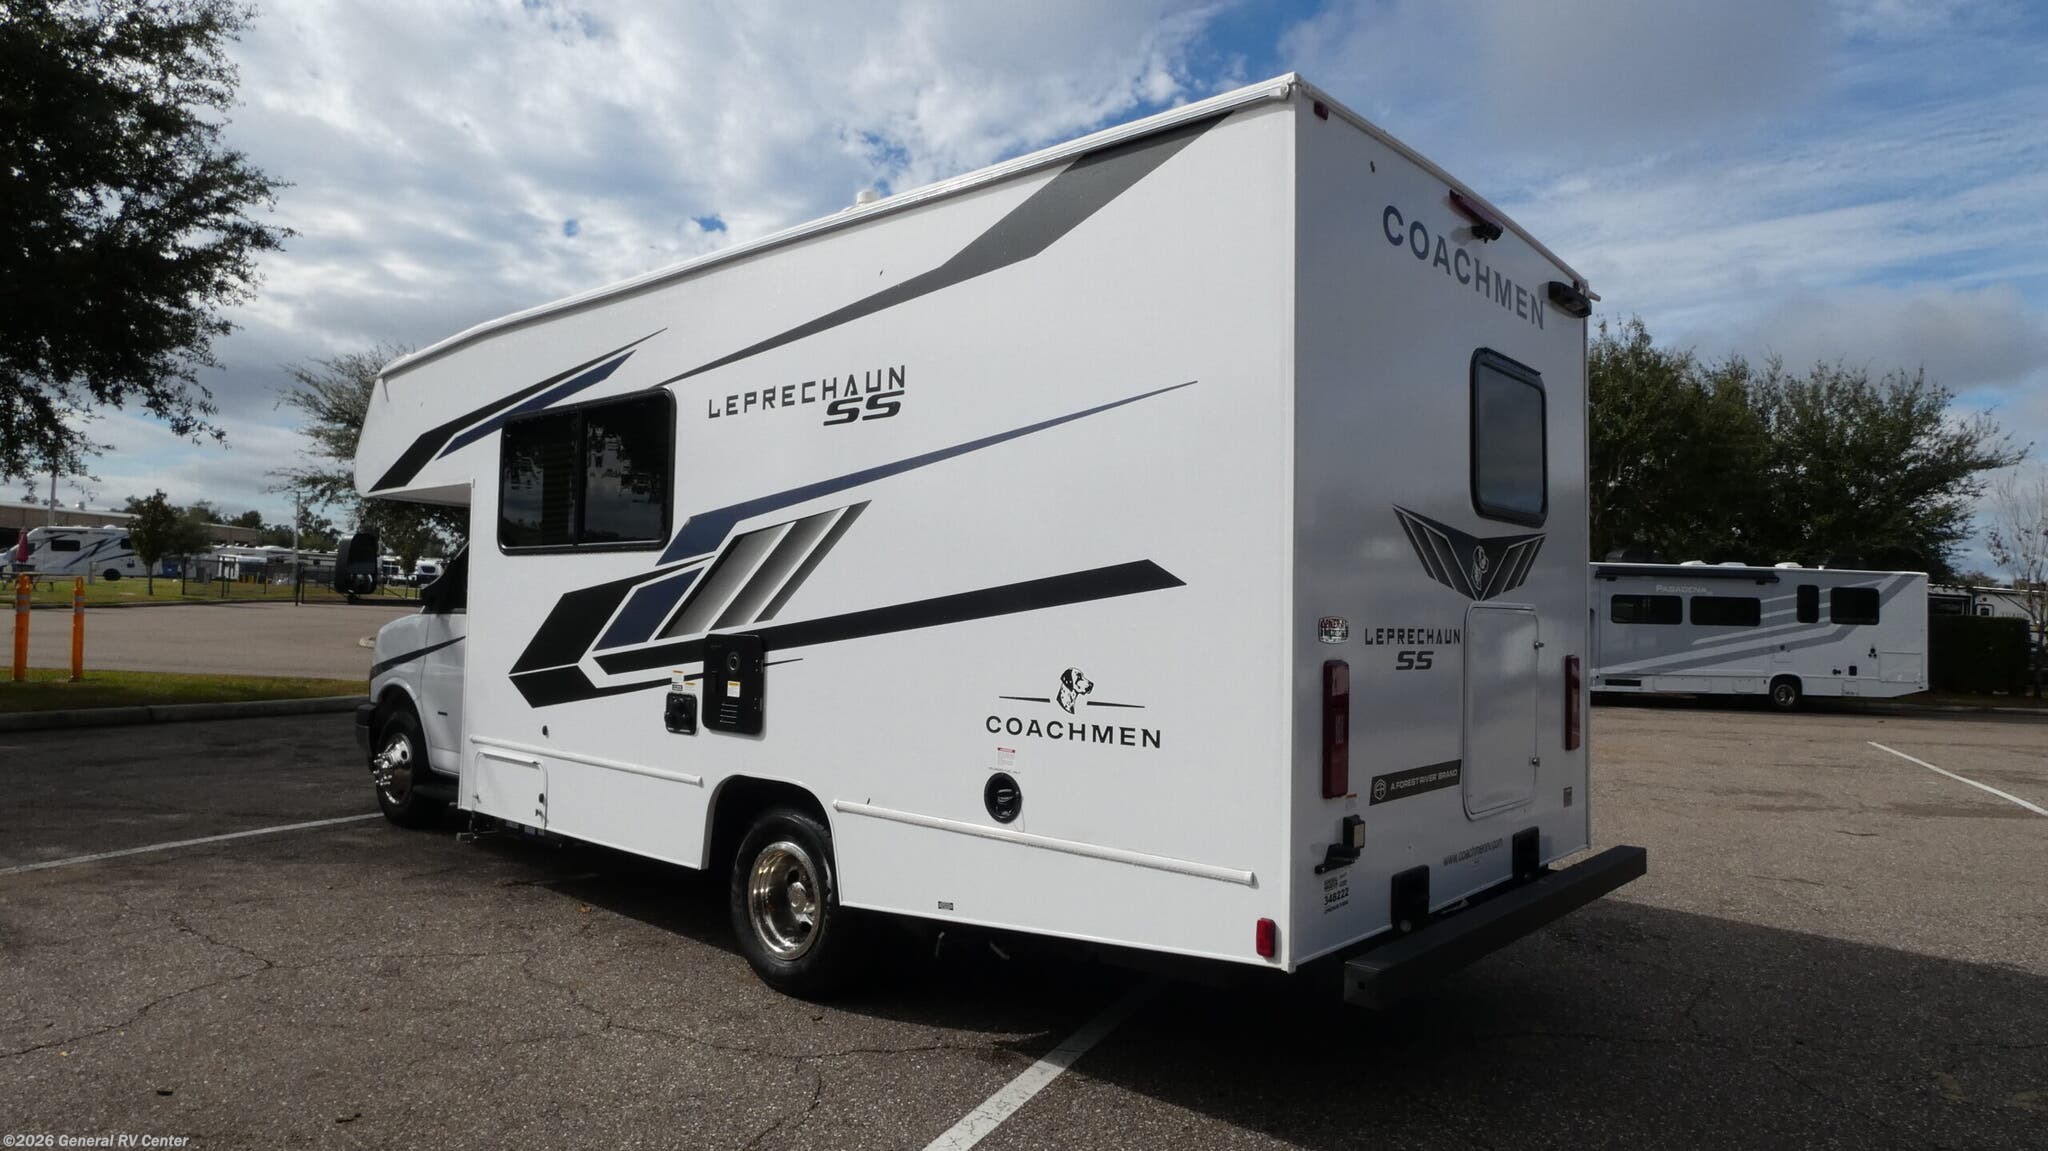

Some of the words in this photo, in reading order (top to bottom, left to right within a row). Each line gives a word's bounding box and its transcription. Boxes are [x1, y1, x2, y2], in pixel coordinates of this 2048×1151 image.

[1383, 205, 1544, 330] COACHMEN
[708, 365, 905, 419] LEPRECHAUN
[823, 390, 905, 426] SS
[1365, 628, 1460, 645] LEPRECHAUN
[1395, 651, 1434, 671] SS
[985, 715, 1161, 749] COACHMEN
[1437, 769, 1458, 780] BRAND
